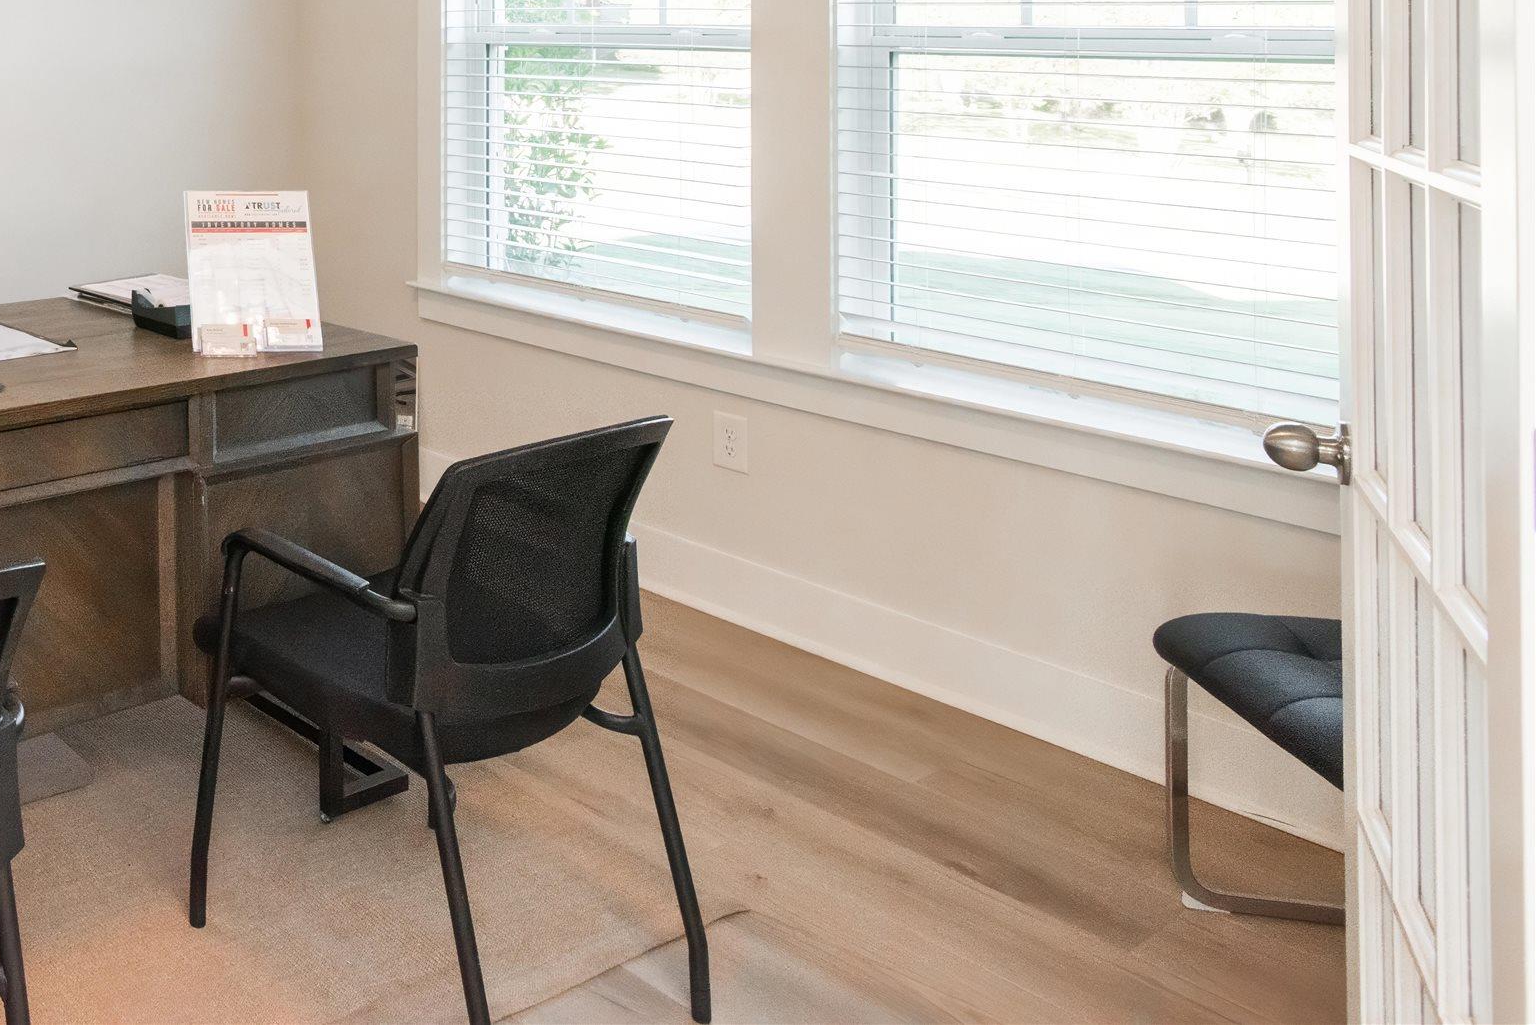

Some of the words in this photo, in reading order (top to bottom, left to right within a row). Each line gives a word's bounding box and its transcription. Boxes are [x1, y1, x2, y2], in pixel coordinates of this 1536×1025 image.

[197, 204, 212, 212] FOR
[216, 204, 236, 212] SALE
[252, 202, 281, 210] TRUST
